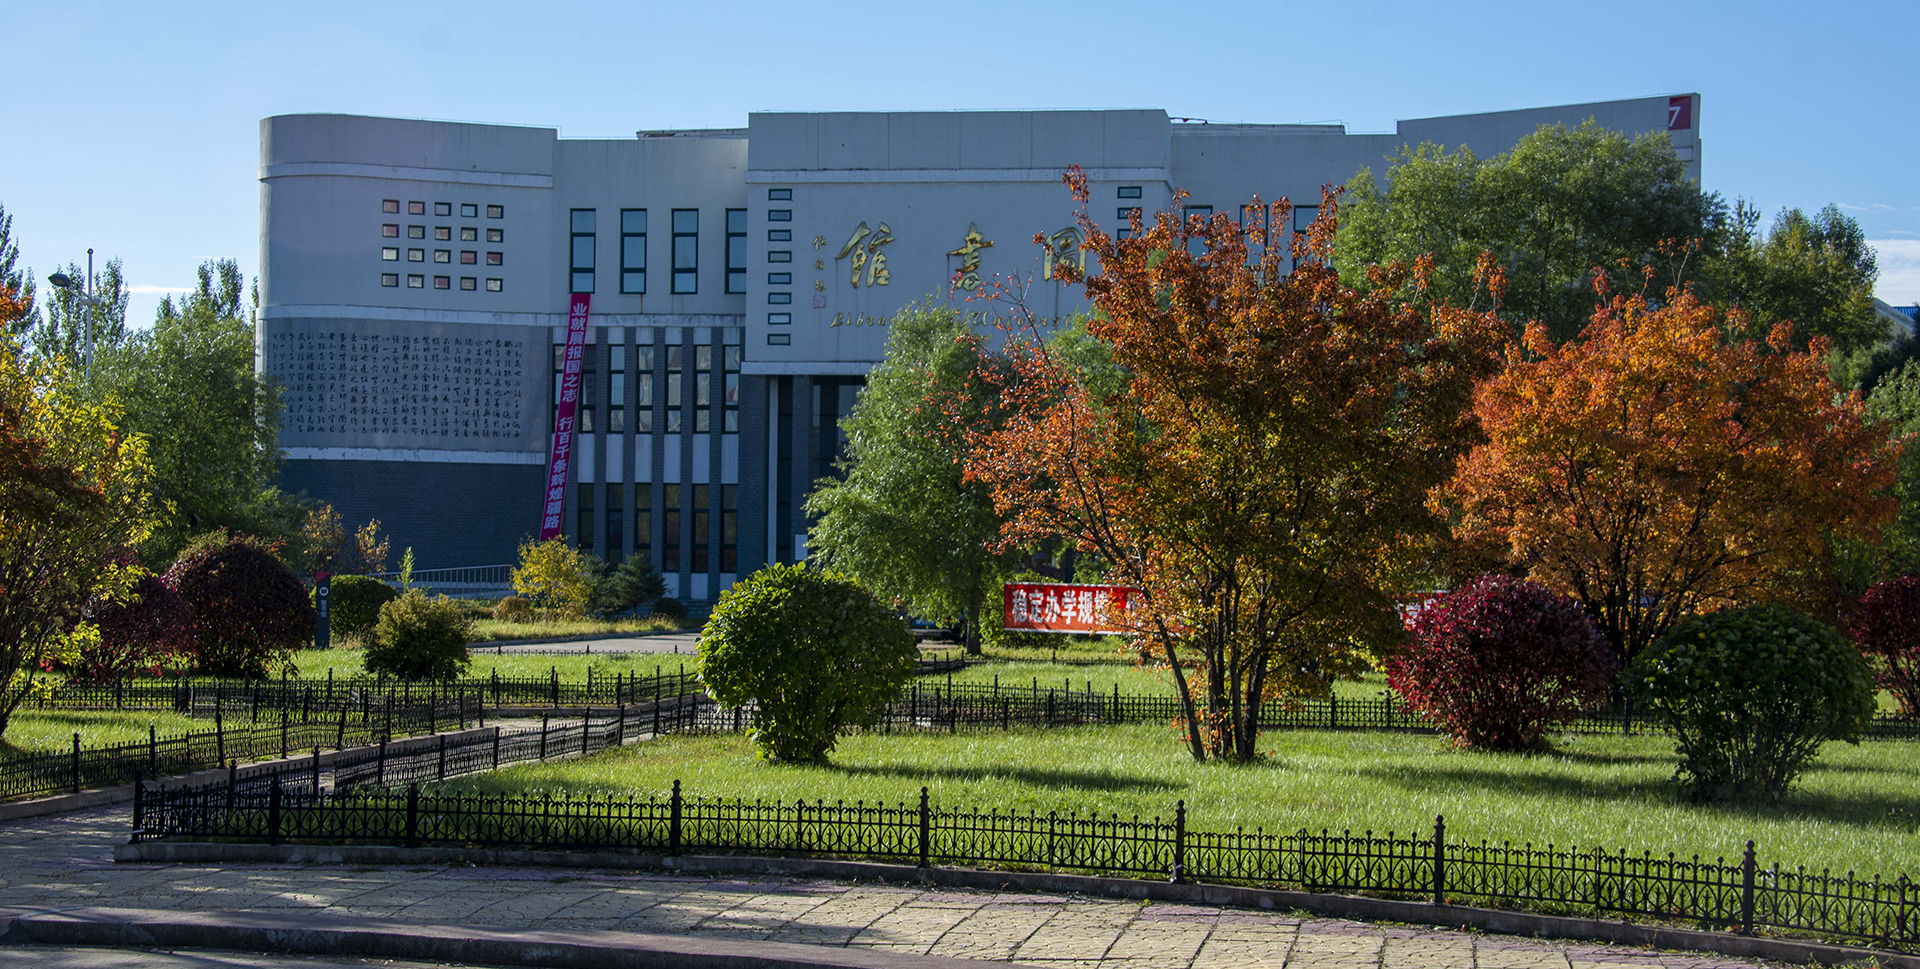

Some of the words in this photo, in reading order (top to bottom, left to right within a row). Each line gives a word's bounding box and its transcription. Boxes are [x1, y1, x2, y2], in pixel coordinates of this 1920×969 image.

[1668, 106, 1682, 127] 7
[563, 303, 587, 402] 业就展报国之志
